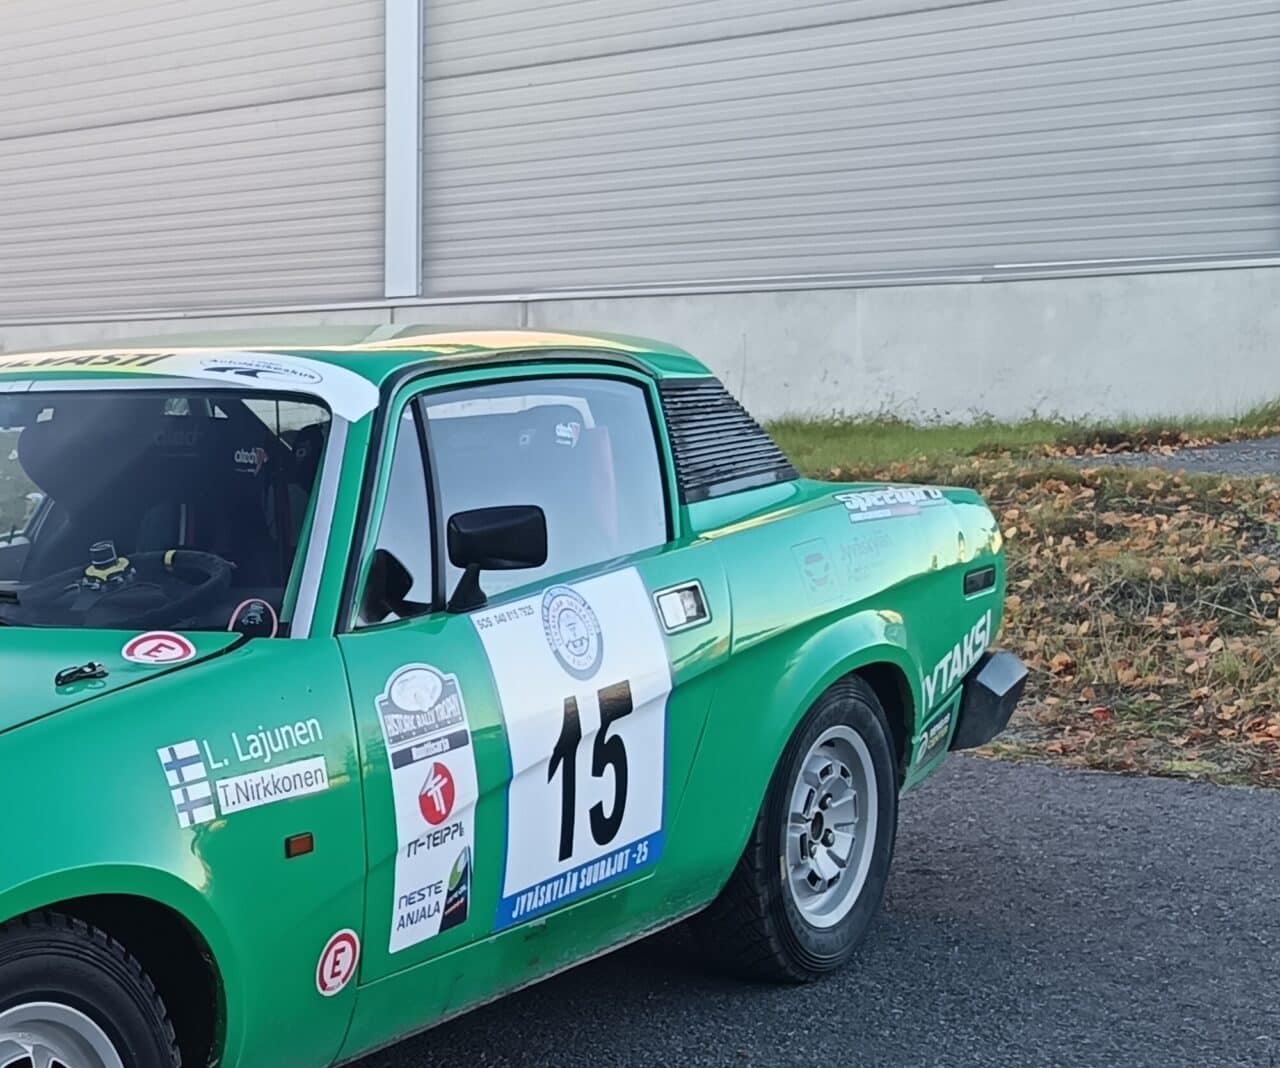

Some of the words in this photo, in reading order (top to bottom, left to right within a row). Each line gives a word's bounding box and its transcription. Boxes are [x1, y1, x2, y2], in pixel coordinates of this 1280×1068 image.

[202, 739, 230, 769] L.
[231, 718, 324, 763] Lajunen
[219, 768, 325, 808] T.Nirkkonen
[547, 679, 633, 862] 15
[397, 880, 444, 910] NESTE
[396, 901, 441, 932] ANJALA
[330, 945, 347, 979] E
